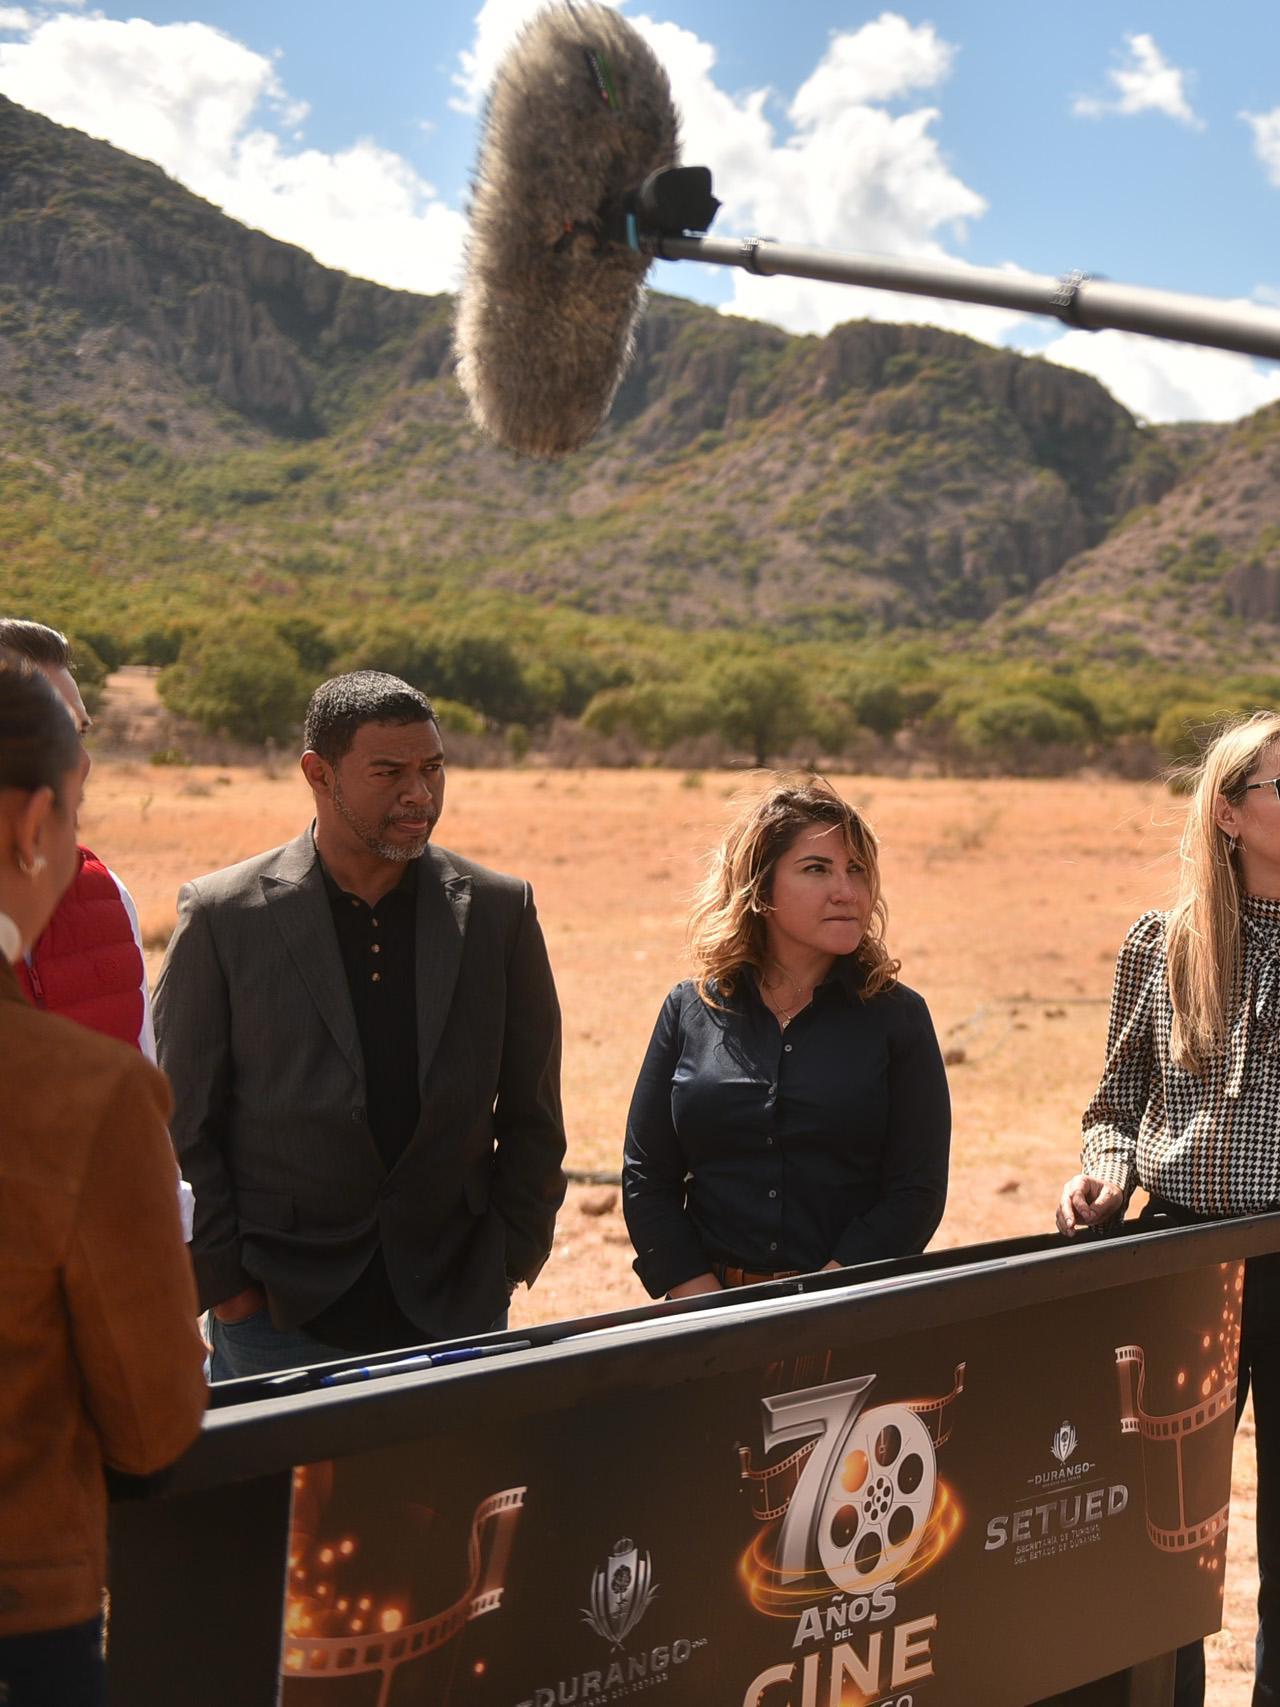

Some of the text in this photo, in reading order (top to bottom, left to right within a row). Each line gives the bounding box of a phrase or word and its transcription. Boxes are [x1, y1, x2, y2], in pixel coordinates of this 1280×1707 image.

[984, 1484, 1129, 1551] SETUED
[792, 1580, 897, 1649] AÑOS
[834, 1628, 854, 1641] DEL
[742, 1613, 938, 1707] CINE
